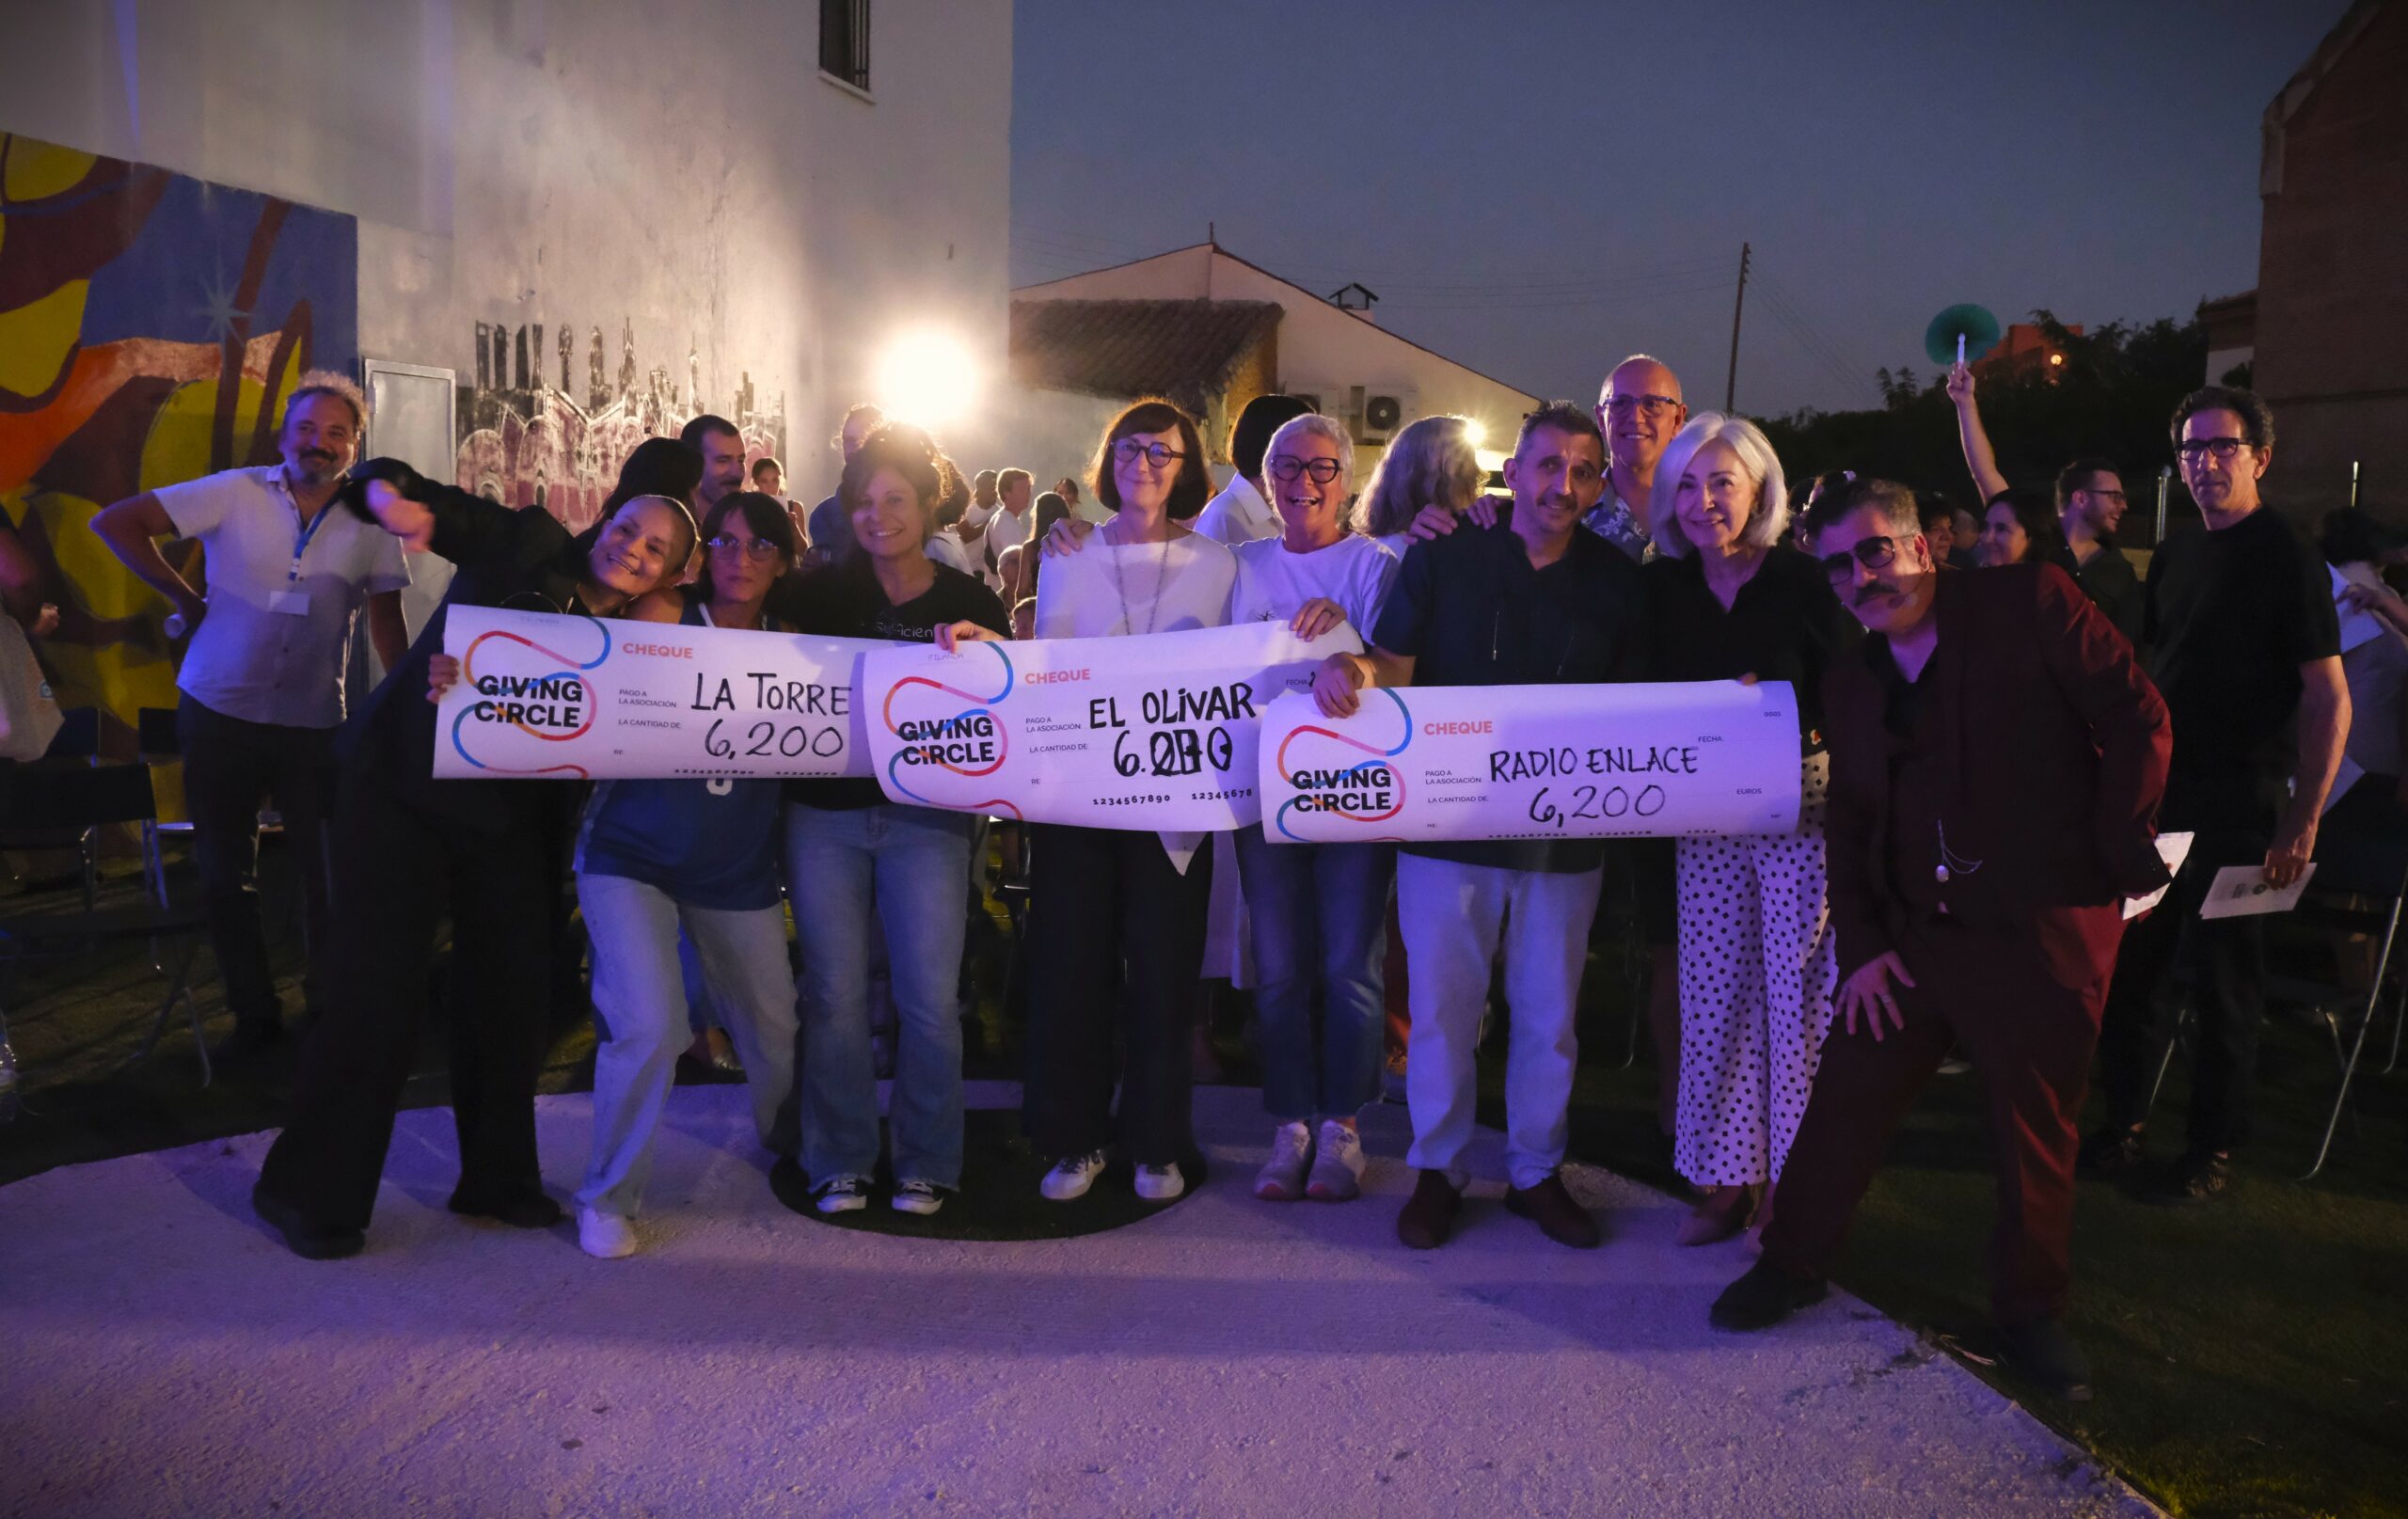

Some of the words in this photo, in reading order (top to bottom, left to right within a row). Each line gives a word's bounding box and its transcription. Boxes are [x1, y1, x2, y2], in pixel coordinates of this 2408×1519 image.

[622, 642, 693, 658] CHEQUE
[477, 675, 583, 703] GIVING
[1024, 669, 1091, 685] CHEQUE
[690, 672, 736, 710] LA
[747, 672, 852, 716] TORRE
[474, 701, 580, 728] CIRCLE
[629, 719, 670, 728] CANTIDAD
[1089, 697, 1126, 729] EL
[705, 719, 843, 760] 6,200
[898, 717, 993, 741] GIVING
[1423, 720, 1493, 736] CHEQUE
[902, 741, 995, 766] CIRCLE
[1039, 743, 1077, 752] CANTIDAD
[1489, 747, 1577, 783] RADIO
[1586, 745, 1699, 774] ENLACE
[1292, 767, 1391, 789] GIVING
[1092, 794, 1170, 805] 1234567890
[1191, 788, 1253, 800] 12345678
[1293, 792, 1391, 813] CIRCLE
[1529, 784, 1666, 828] 6,200
